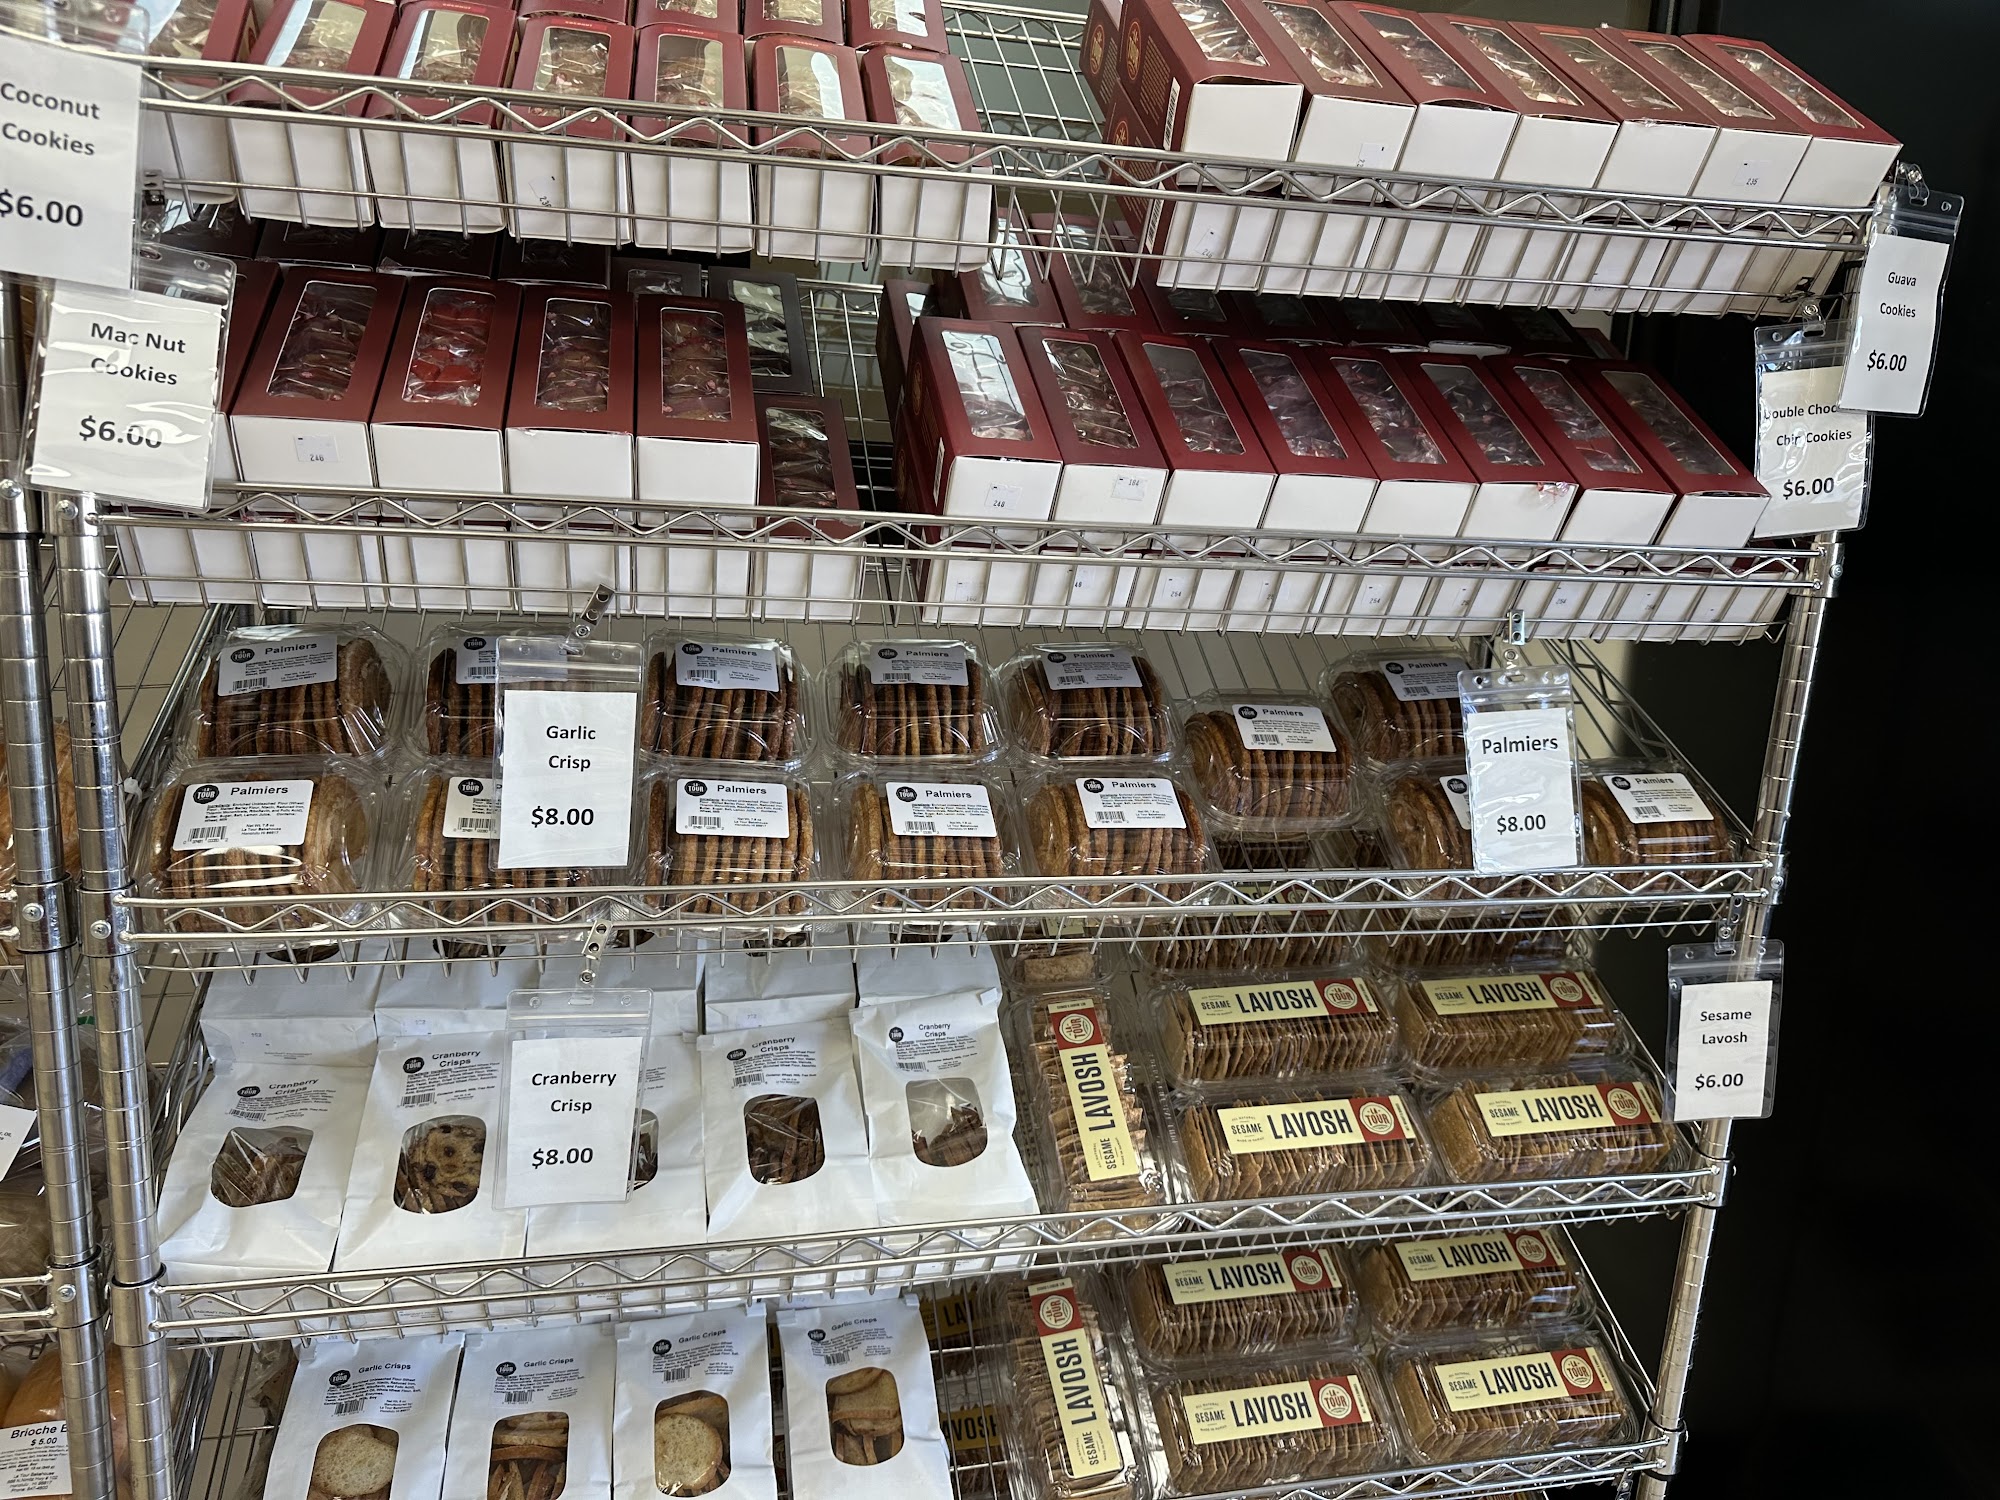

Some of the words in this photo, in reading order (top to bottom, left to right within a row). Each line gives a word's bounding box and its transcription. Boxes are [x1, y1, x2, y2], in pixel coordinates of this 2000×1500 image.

[1, 82, 101, 120] Coconut
[1, 122, 95, 156] Cookies
[0, 188, 84, 228] $6.00
[1887, 271, 1917, 288] Guava
[1880, 301, 1916, 318] Cookies
[90, 322, 139, 346] Mac
[146, 332, 187, 354] Nut
[1866, 350, 1907, 373] $6.00
[90, 357, 178, 386] Cookies
[78, 415, 164, 449] $6.00
[1806, 429, 1852, 443] Cookies
[1782, 476, 1835, 501] $6.00
[264, 642, 318, 655] Palmiers
[711, 646, 758, 657] Palmiers
[906, 650, 949, 658] Palmiers
[1408, 661, 1448, 669] Palmiers
[1262, 709, 1304, 717] Palmiers
[546, 725, 597, 740] Garlic
[1481, 735, 1559, 755] Palmiers
[548, 755, 591, 772] Crisp
[1635, 777, 1675, 785] Palmiers
[230, 785, 289, 796] Palmiers
[462, 784, 480, 792] TOUR
[717, 784, 767, 795] Palmiers
[925, 790, 972, 799] Palmiers
[197, 791, 215, 799] TOUR
[531, 805, 594, 828] $8.00
[1496, 814, 1546, 836] $8.00
[1435, 991, 1465, 1001] SESAME
[1466, 981, 1546, 1005] LAVOSH
[1556, 986, 1579, 994] TOUR
[1235, 988, 1318, 1014] LAVOSH
[1329, 992, 1353, 1002] TOUR
[1200, 1000, 1231, 1010] SESAME
[1700, 1010, 1752, 1022] Sesame
[919, 1023, 951, 1031] Cranberry
[1065, 1026, 1072, 1034] LA
[1070, 1017, 1086, 1039] TOUR
[924, 1030, 947, 1038] Crisps
[1702, 1031, 1748, 1045] Lavosh
[751, 1037, 795, 1049] Cranberry
[760, 1044, 790, 1053] Crisps
[432, 1050, 481, 1060] Cranberry
[439, 1059, 471, 1068] Crisps
[268, 1079, 320, 1090] Cranberry
[531, 1070, 617, 1086] Cranberry
[1694, 1073, 1744, 1091] $6.00
[275, 1086, 307, 1096] Crisps
[1071, 1052, 1116, 1133] LAVOSH
[550, 1099, 593, 1114] Crisp
[1521, 1094, 1604, 1123] LAVOSH
[1612, 1099, 1637, 1110] TOUR
[1489, 1107, 1520, 1118] SESAME
[1266, 1109, 1353, 1140] LAVOSH
[1365, 1113, 1390, 1126] TOUR
[1231, 1123, 1263, 1135] SESAME
[531, 1147, 594, 1169] $8.00
[1099, 1137, 1117, 1170] SESAME
[1437, 1241, 1512, 1268] LAVOSH
[1521, 1245, 1543, 1255] TOUR
[1408, 1254, 1436, 1265] SESAME
[1207, 1262, 1285, 1291] LAVOSH
[1297, 1265, 1318, 1275] TOUR
[1175, 1276, 1204, 1287] SESAME
[1053, 1300, 1066, 1323] TOUR
[831, 1321, 853, 1331] Garlic
[854, 1317, 878, 1325] Crisps
[678, 1335, 701, 1344] Garlic
[702, 1329, 727, 1339] Crisps
[358, 1364, 382, 1374] Garlic
[384, 1362, 412, 1371] Crisps
[523, 1360, 547, 1368] Garlic
[549, 1357, 574, 1365] Crisps
[1479, 1362, 1558, 1395] LAVOSH
[1567, 1367, 1589, 1379] TOUR
[1052, 1338, 1097, 1425] LAVOSH
[1448, 1379, 1478, 1392] SESAME
[1324, 1396, 1348, 1408] TOUR
[1230, 1392, 1312, 1427] LAVOSH
[1195, 1410, 1226, 1423] SESAME
[11, 1426, 57, 1438] Brioche
[38, 1437, 57, 1445] 5.00
[1082, 1431, 1099, 1465] SESAME
